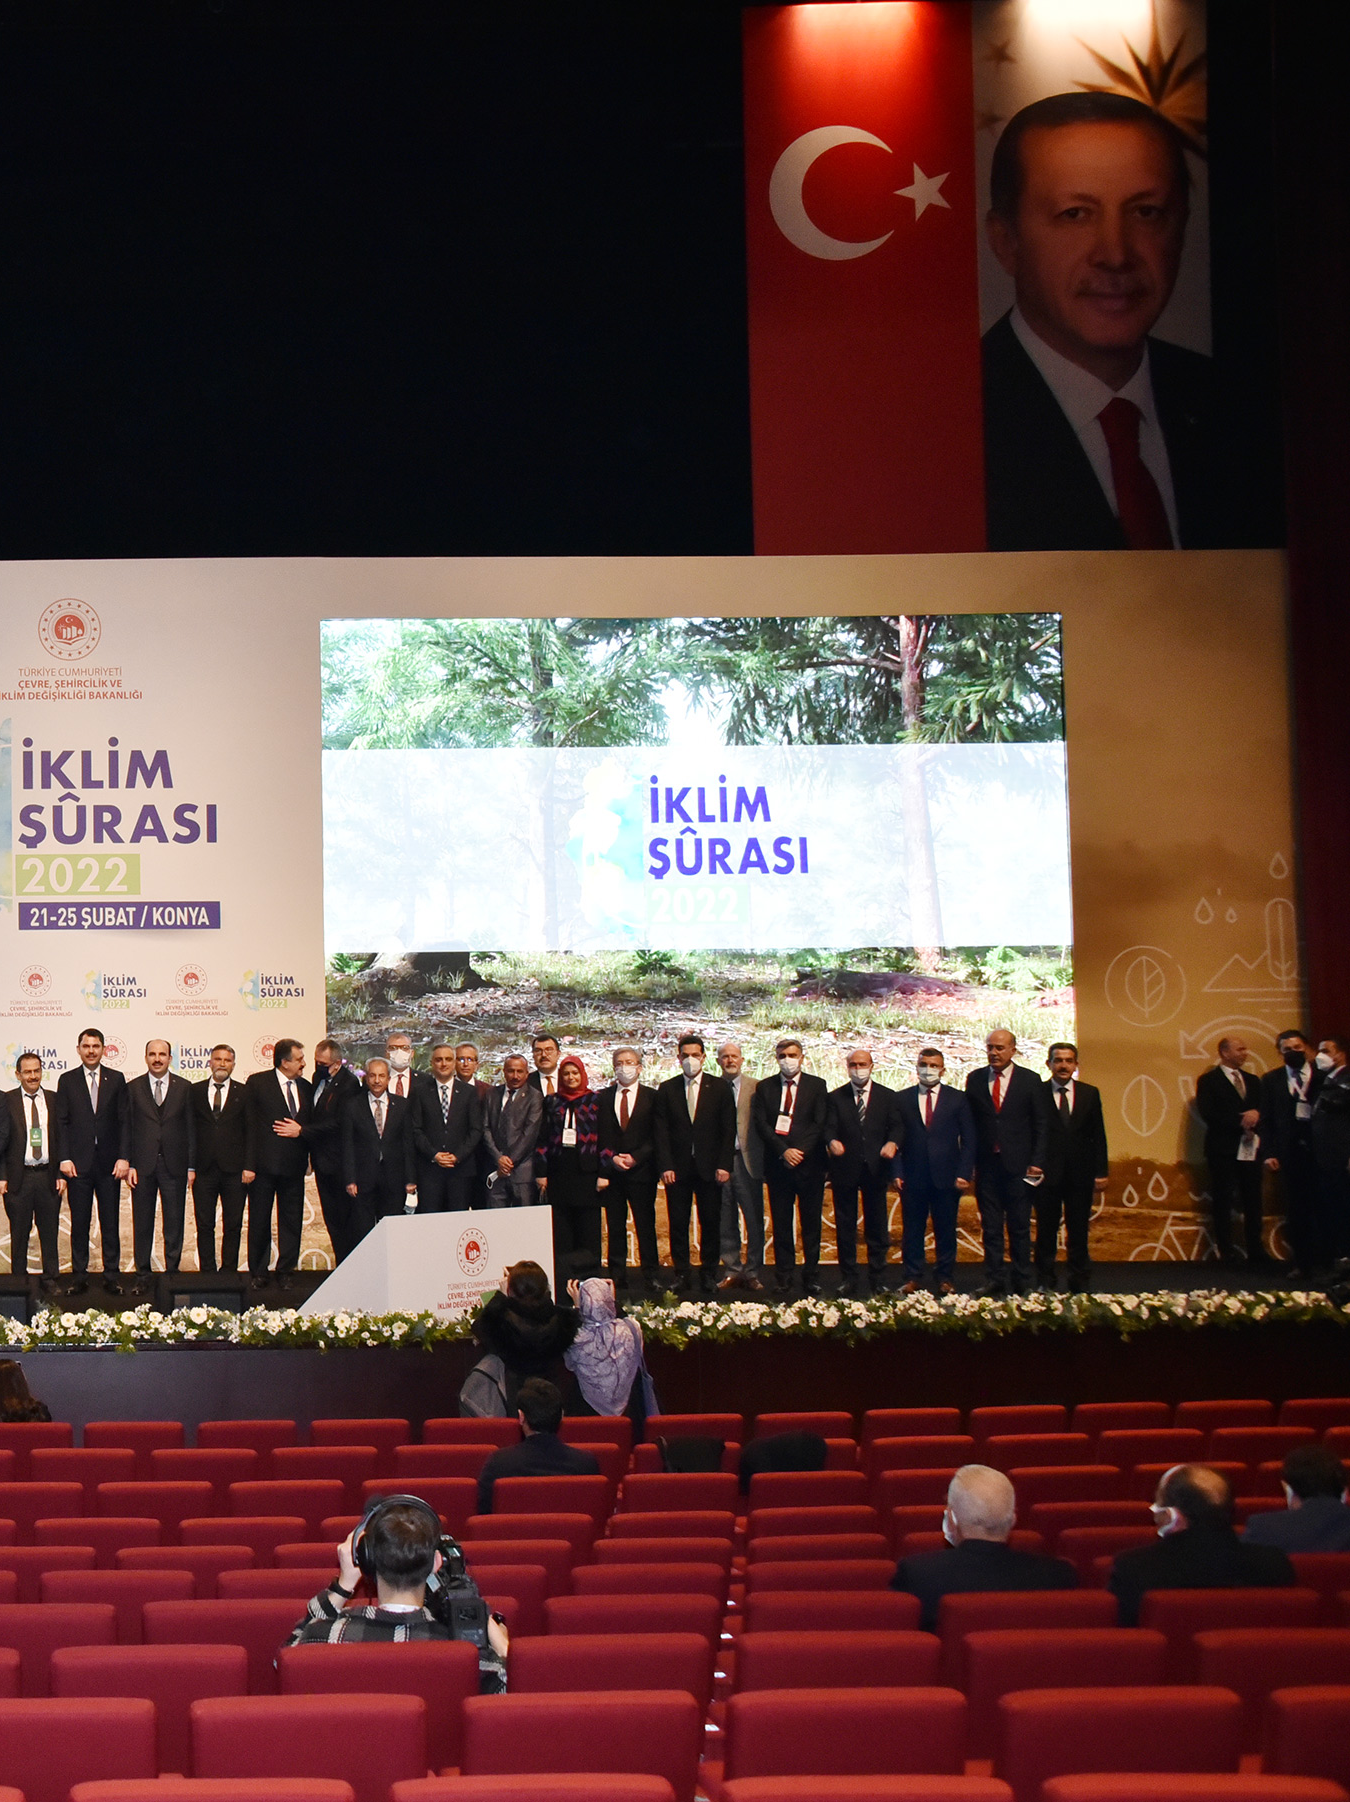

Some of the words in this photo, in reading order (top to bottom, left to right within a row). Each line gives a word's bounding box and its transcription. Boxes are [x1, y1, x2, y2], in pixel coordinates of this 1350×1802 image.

[18, 667, 56, 677] TÜRKİYE
[58, 666, 122, 677] CUMHURİYETİ
[18, 679, 52, 690] ÇEVRE,
[54, 678, 108, 690] ŞEHİRCİLİK
[110, 679, 122, 688] VE
[28, 690, 86, 702] DEĞİŞİKLİĞİ
[88, 689, 142, 700] BAKANLIĞI
[22, 736, 173, 790] İKLİM
[650, 774, 771, 823] İKLİM
[18, 791, 218, 849] ŞÛRASI
[648, 826, 809, 880] ŞÛRASI
[22, 857, 128, 893] 2022
[651, 886, 739, 923] 2022
[30, 907, 77, 927] 21-25
[81, 907, 136, 929] ŞUBAT
[152, 906, 210, 926] KONYA
[103, 974, 137, 986] İKLİM
[261, 973, 294, 985] İKLİM
[103, 986, 147, 999] ŞÛRASI
[260, 985, 304, 998] ŞÛRASI
[104, 1000, 128, 1008] 2022
[261, 999, 286, 1007] 2022
[180, 1045, 213, 1057] İKLİM
[180, 1057, 211, 1070] ŞÛRA
[180, 1071, 205, 1080] 2022
